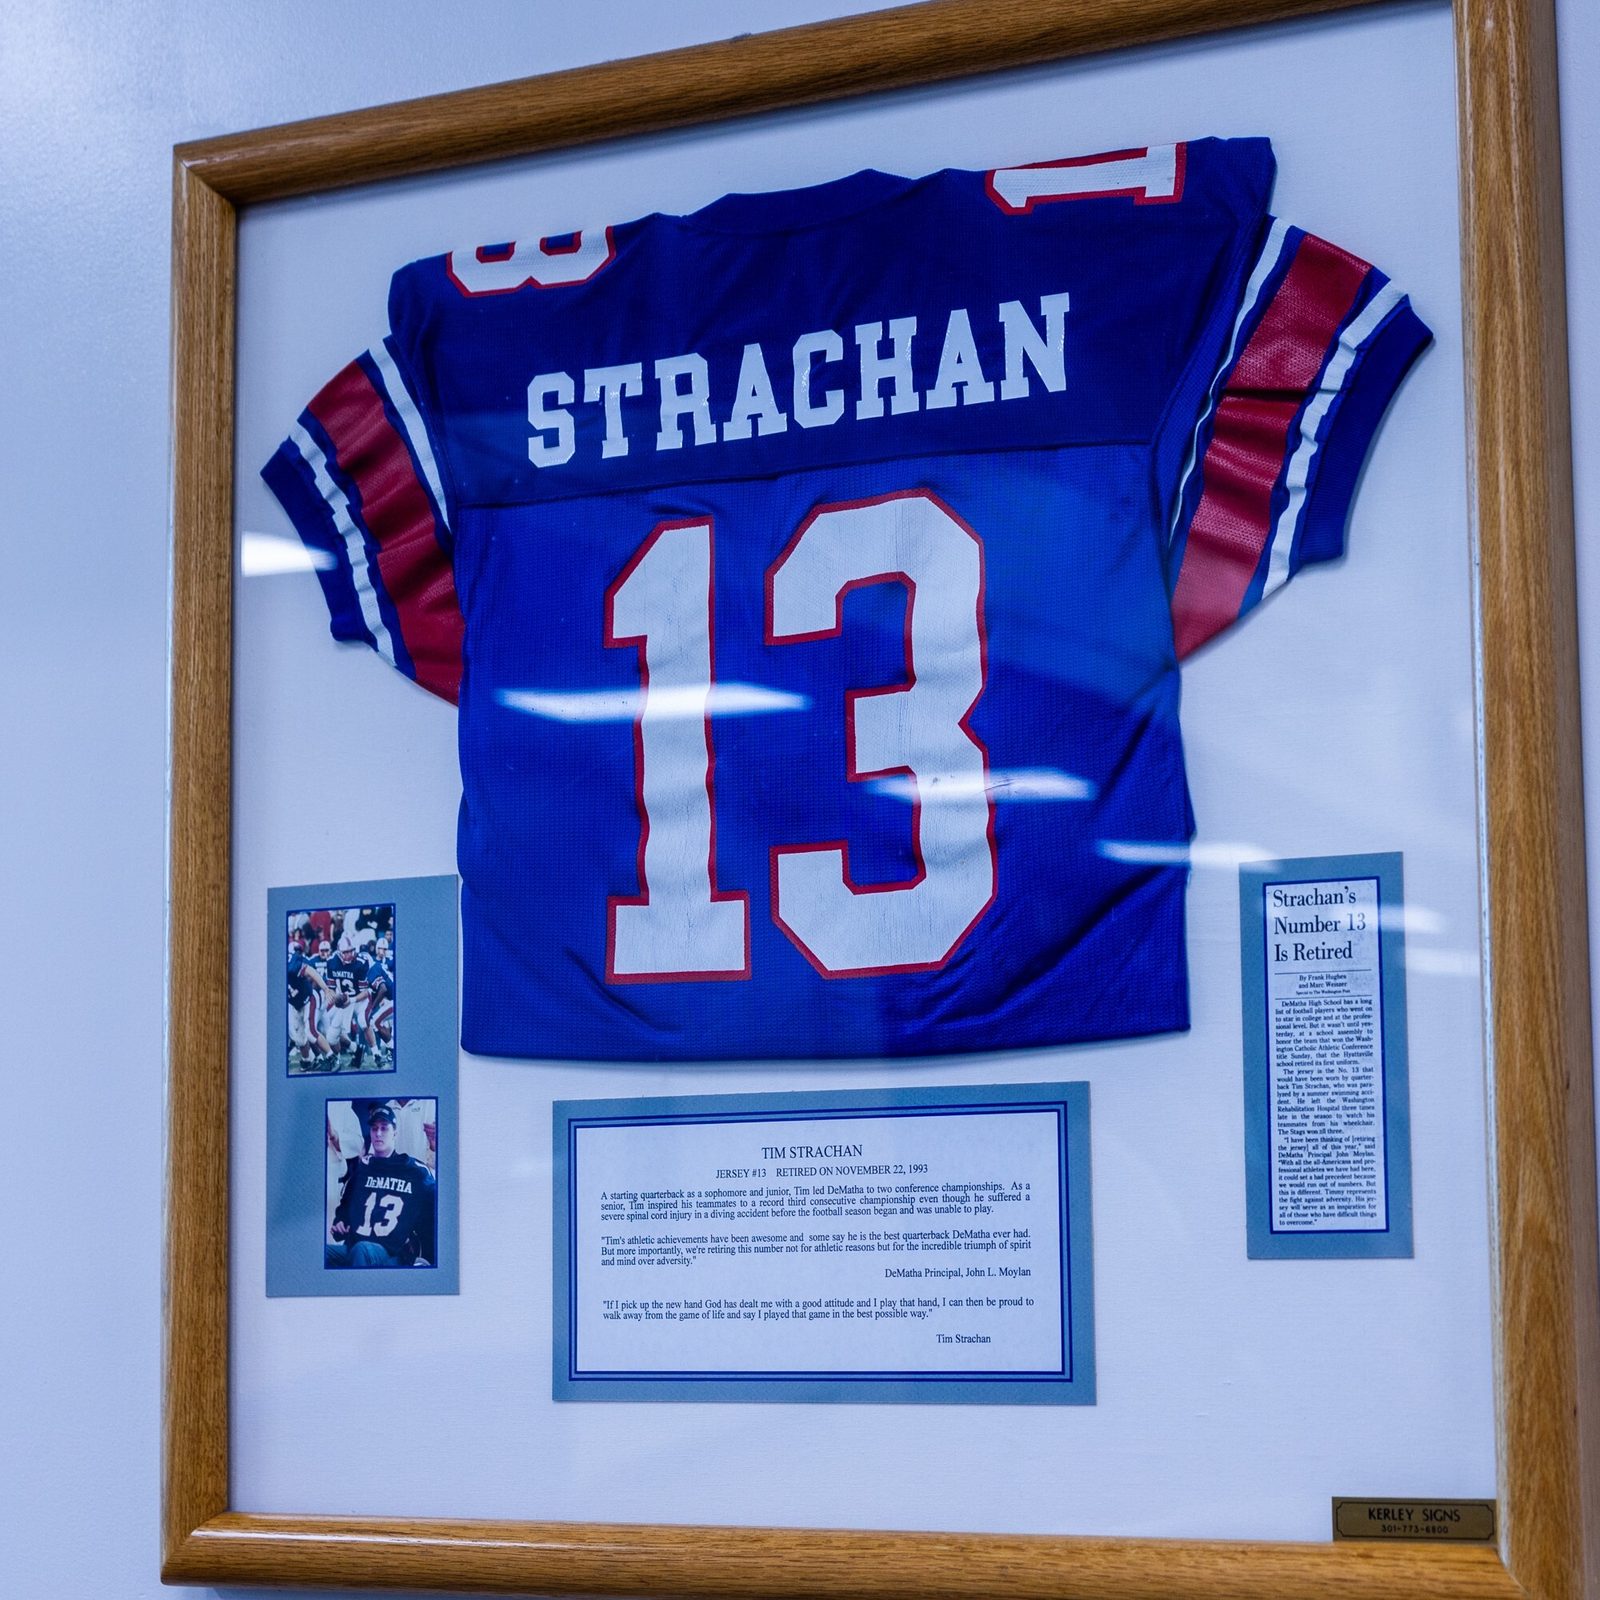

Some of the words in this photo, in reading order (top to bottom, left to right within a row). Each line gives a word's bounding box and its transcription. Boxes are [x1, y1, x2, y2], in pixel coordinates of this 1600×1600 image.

[527, 292, 1071, 469] STRACHAN
[604, 487, 998, 985] 13
[1274, 915, 1340, 934] Number
[1347, 912, 1366, 932] 13
[1275, 944, 1288, 962] Is
[1293, 940, 1352, 961] Retired
[762, 1147, 785, 1159] TIM
[789, 1145, 863, 1158] STRACHAN
[716, 1168, 749, 1178] JERSEY
[752, 1168, 766, 1178] #13
[776, 1166, 817, 1177] RETIRED
[819, 1166, 833, 1176] ON
[835, 1165, 890, 1175] NOVEMBER
[893, 1164, 905, 1175] 22,
[909, 1164, 928, 1174] 1993
[601, 1191, 607, 1200] A
[610, 1190, 638, 1202] starting
[640, 1188, 684, 1202] quarterback
[704, 1188, 746, 1200] sophomore
[749, 1187, 763, 1197] and
[766, 1187, 791, 1199] junior,
[795, 1187, 809, 1196] Tim
[812, 1186, 824, 1195] led
[827, 1185, 864, 1195] DeMatha
[866, 1186, 874, 1194] to
[877, 1185, 892, 1194] two
[894, 1183, 939, 1193] conference
[941, 1181, 1004, 1194] championships.
[1010, 1181, 1022, 1190] As
[356, 1192, 404, 1237] 13
[626, 1210, 648, 1222] spinal
[650, 1209, 667, 1219] cord
[669, 1210, 692, 1221] injury
[694, 1209, 701, 1218] in
[710, 1208, 735, 1220] diving
[736, 1208, 768, 1218] accident
[771, 1207, 795, 1217] before
[798, 1207, 810, 1216] the
[812, 1206, 842, 1216] football
[844, 1208, 871, 1216] season
[873, 1205, 897, 1217] began
[899, 1205, 914, 1215] and
[934, 1204, 961, 1214] unable
[963, 1205, 972, 1213] to
[974, 1203, 994, 1216] play.
[627, 1235, 654, 1244] athletic
[656, 1234, 708, 1244] achievements
[710, 1233, 728, 1243] have
[730, 1233, 749, 1243] been
[751, 1235, 787, 1243] awesome
[789, 1232, 804, 1242] and
[832, 1234, 845, 1244] say
[847, 1231, 857, 1241] he
[860, 1232, 866, 1241] is
[869, 1231, 881, 1241] the
[883, 1231, 899, 1240] best
[902, 1230, 949, 1243] quarterback
[952, 1229, 990, 1239] DeMatha
[1013, 1228, 1031, 1238] had.
[601, 1246, 614, 1255] But
[638, 1245, 683, 1257] importantly,
[707, 1244, 735, 1256] retiring
[737, 1243, 751, 1253] this
[753, 1243, 783, 1253] number
[785, 1244, 798, 1252] not
[800, 1242, 812, 1252] for
[814, 1242, 843, 1252] athletic
[877, 1241, 889, 1251] but
[892, 1241, 904, 1251] for
[906, 1241, 919, 1251] the
[921, 1240, 961, 1251] incredible
[963, 1240, 996, 1252] triumph
[998, 1240, 1007, 1250] of
[1009, 1240, 1032, 1252] spirit
[601, 1256, 614, 1266] and
[616, 1256, 635, 1266] mind
[885, 1268, 922, 1278] DeMatha
[924, 1267, 963, 1280] Principal,
[965, 1267, 985, 1277] John
[987, 1267, 996, 1277] L.
[999, 1267, 1032, 1279] Moylan
[603, 1310, 621, 1319] walk
[623, 1312, 642, 1322] away
[645, 1309, 663, 1319] from
[665, 1309, 677, 1319] the
[679, 1312, 699, 1322] game
[701, 1309, 709, 1319] of
[712, 1309, 724, 1319] life
[726, 1309, 740, 1319] and
[742, 1312, 755, 1321] say
[758, 1309, 761, 1318] I
[763, 1309, 789, 1321] played
[791, 1309, 806, 1318] that
[808, 1311, 830, 1321] game
[832, 1309, 840, 1318] in
[842, 1308, 854, 1318] the
[856, 1308, 872, 1318] best
[874, 1308, 907, 1321] possible
[936, 1334, 952, 1343] Tim
[955, 1333, 992, 1343] Strachan
[1368, 1507, 1414, 1521] KERLEY
[1422, 1508, 1461, 1522] SIGNS
